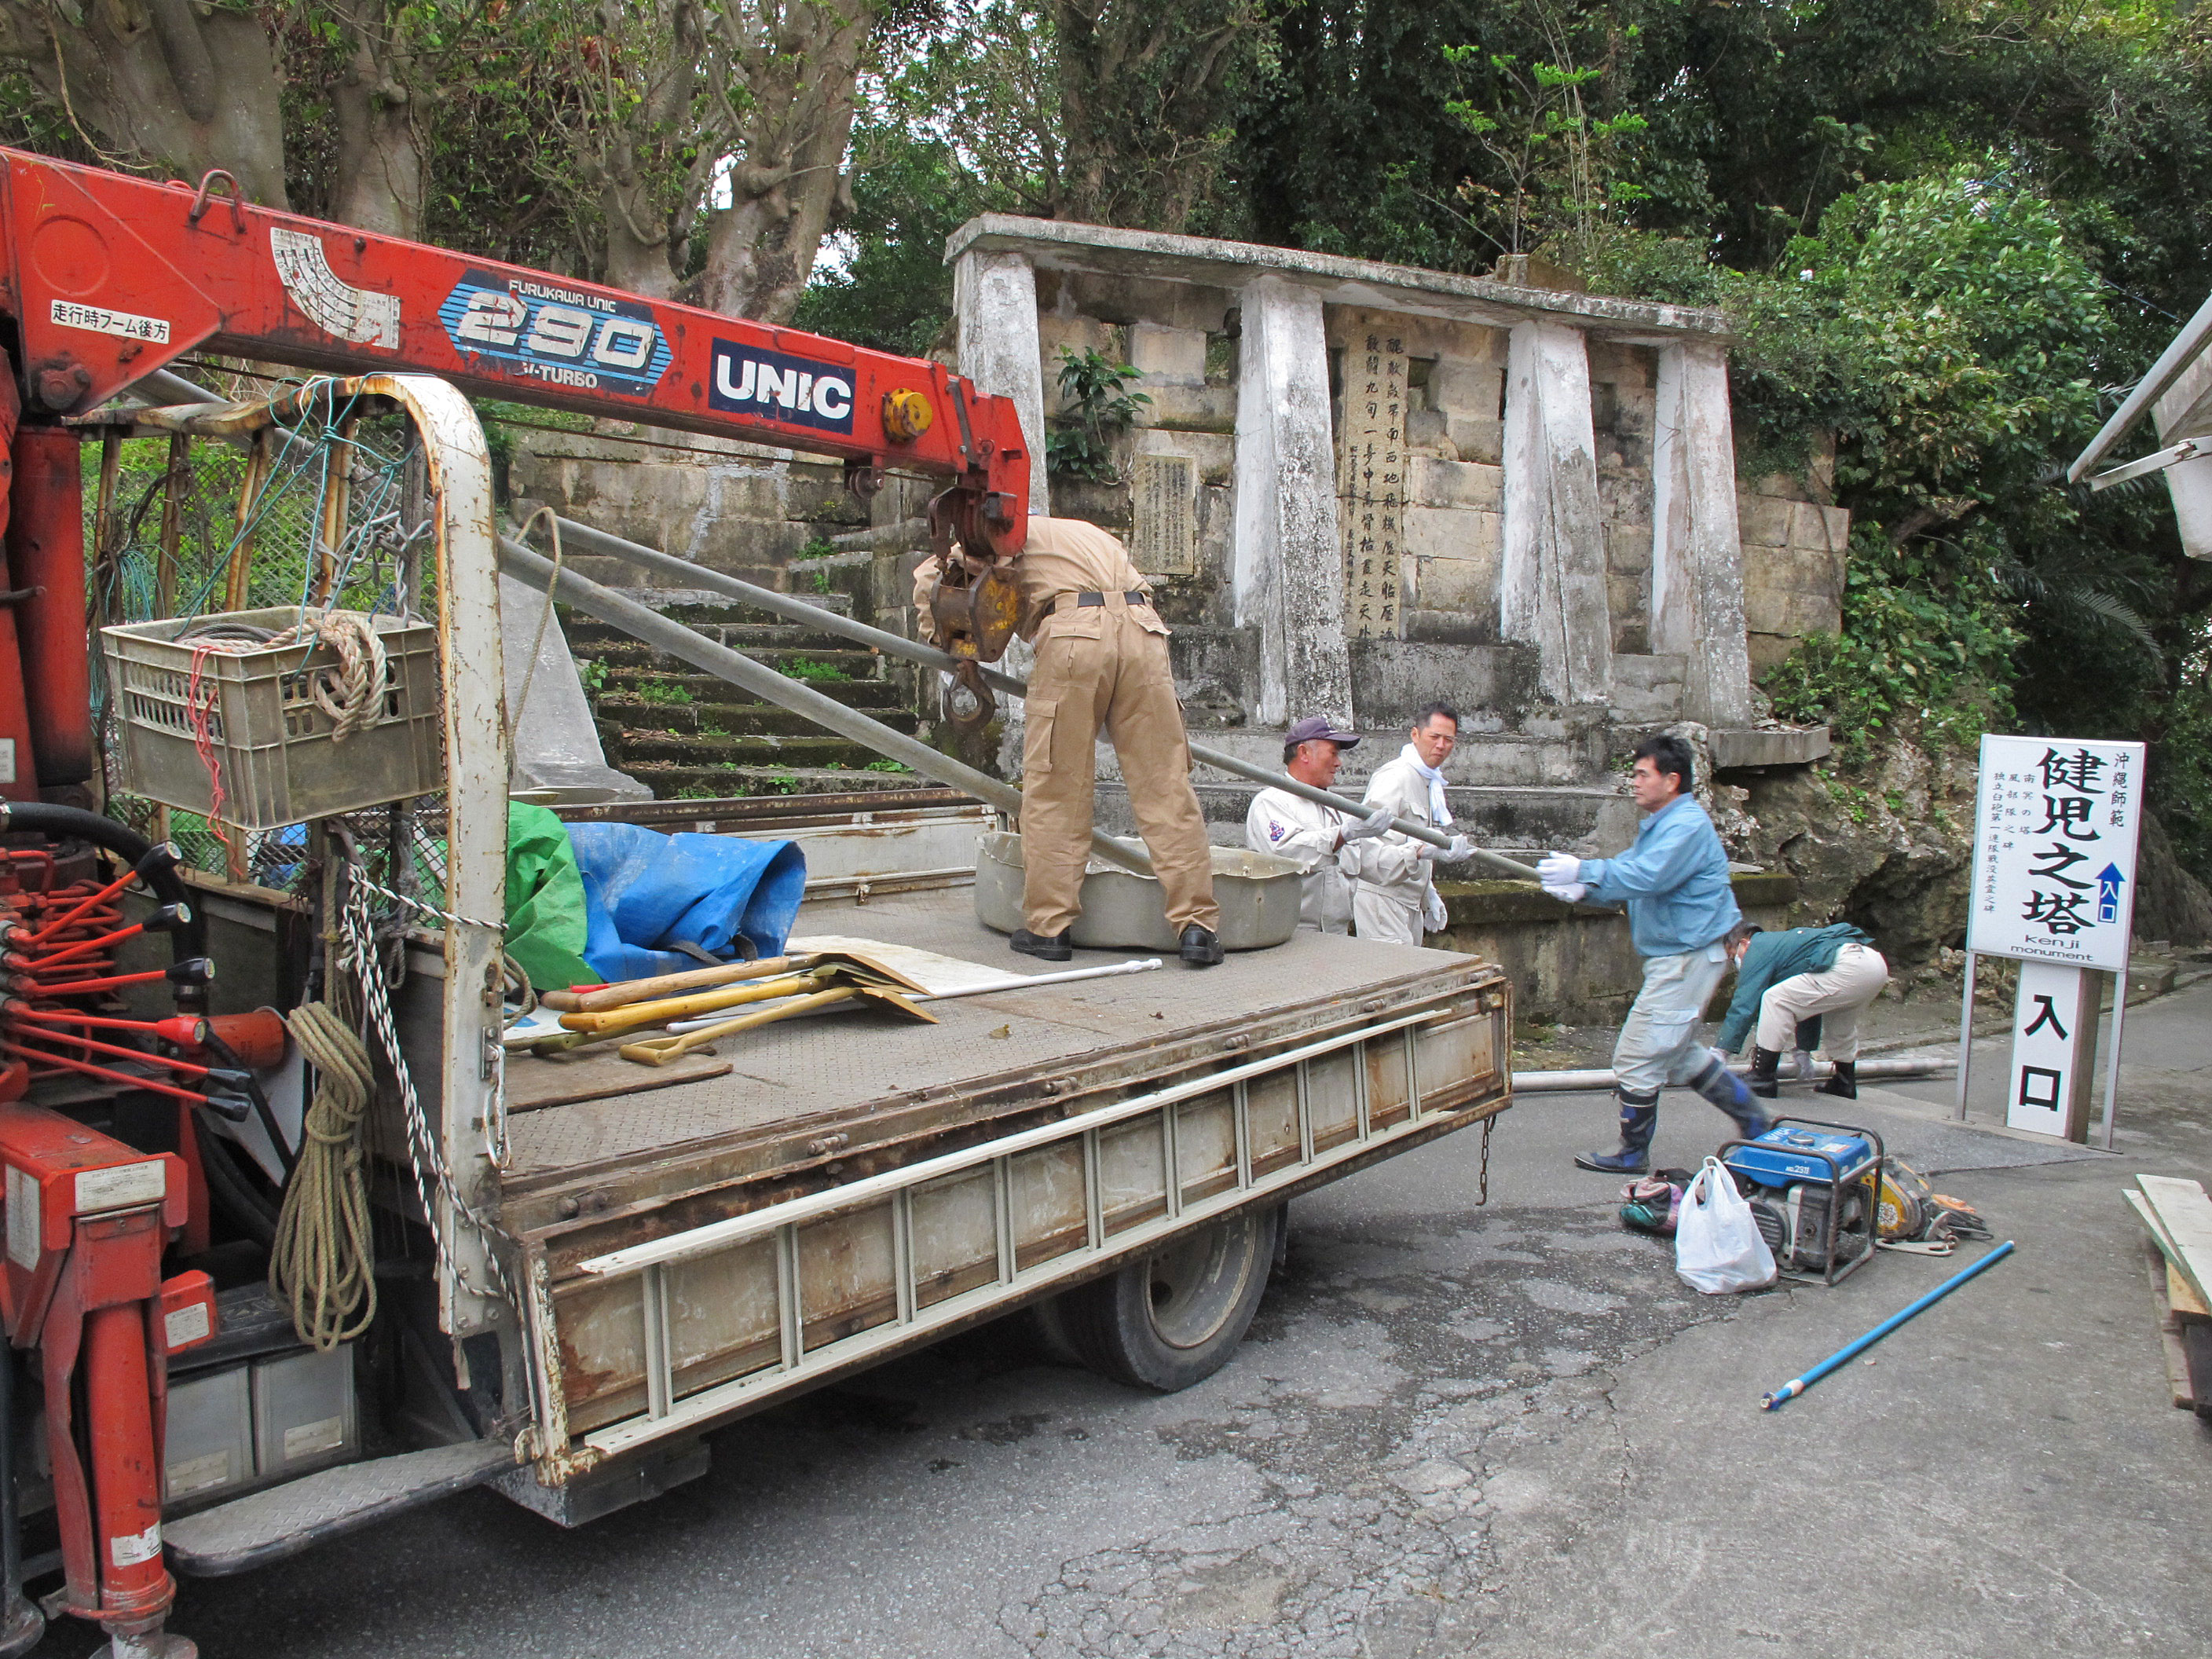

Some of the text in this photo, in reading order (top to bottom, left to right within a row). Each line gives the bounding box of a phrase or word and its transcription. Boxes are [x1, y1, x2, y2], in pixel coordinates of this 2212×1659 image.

[53, 303, 167, 340] 走行時ブーム後方
[509, 280, 617, 313] FURUKAWA UNIC
[456, 291, 655, 369] 290
[716, 354, 851, 419] UNIC
[2021, 747, 2108, 935] 健児之塔
[2100, 881, 2117, 922] 入口
[2011, 945, 2093, 961] monument
[2019, 994, 2068, 1111] 入口
